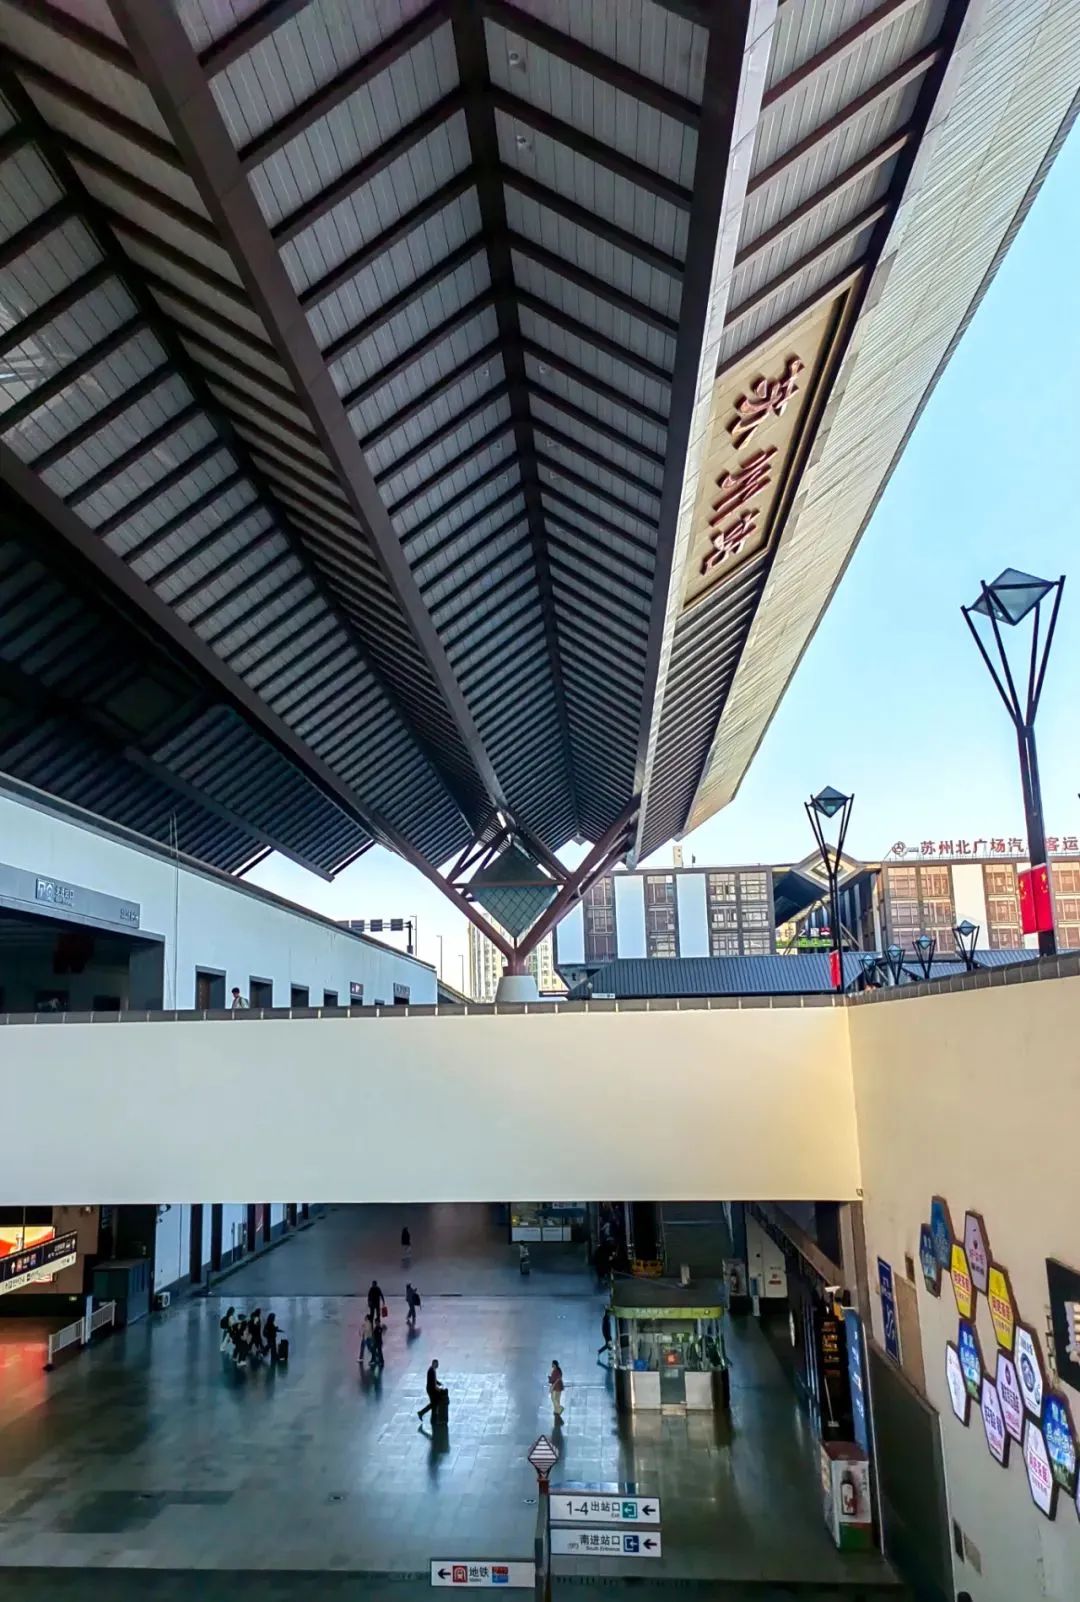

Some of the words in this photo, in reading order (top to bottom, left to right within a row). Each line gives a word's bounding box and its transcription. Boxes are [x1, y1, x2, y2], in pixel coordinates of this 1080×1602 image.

[701, 353, 806, 576] 苏州站
[920, 836, 1079, 855] 苏州北广场汽客运
[566, 1501, 589, 1516] 1-4
[591, 1500, 620, 1512] 出站口
[580, 1534, 620, 1546] 南进站口
[469, 1566, 489, 1578] 地铁
